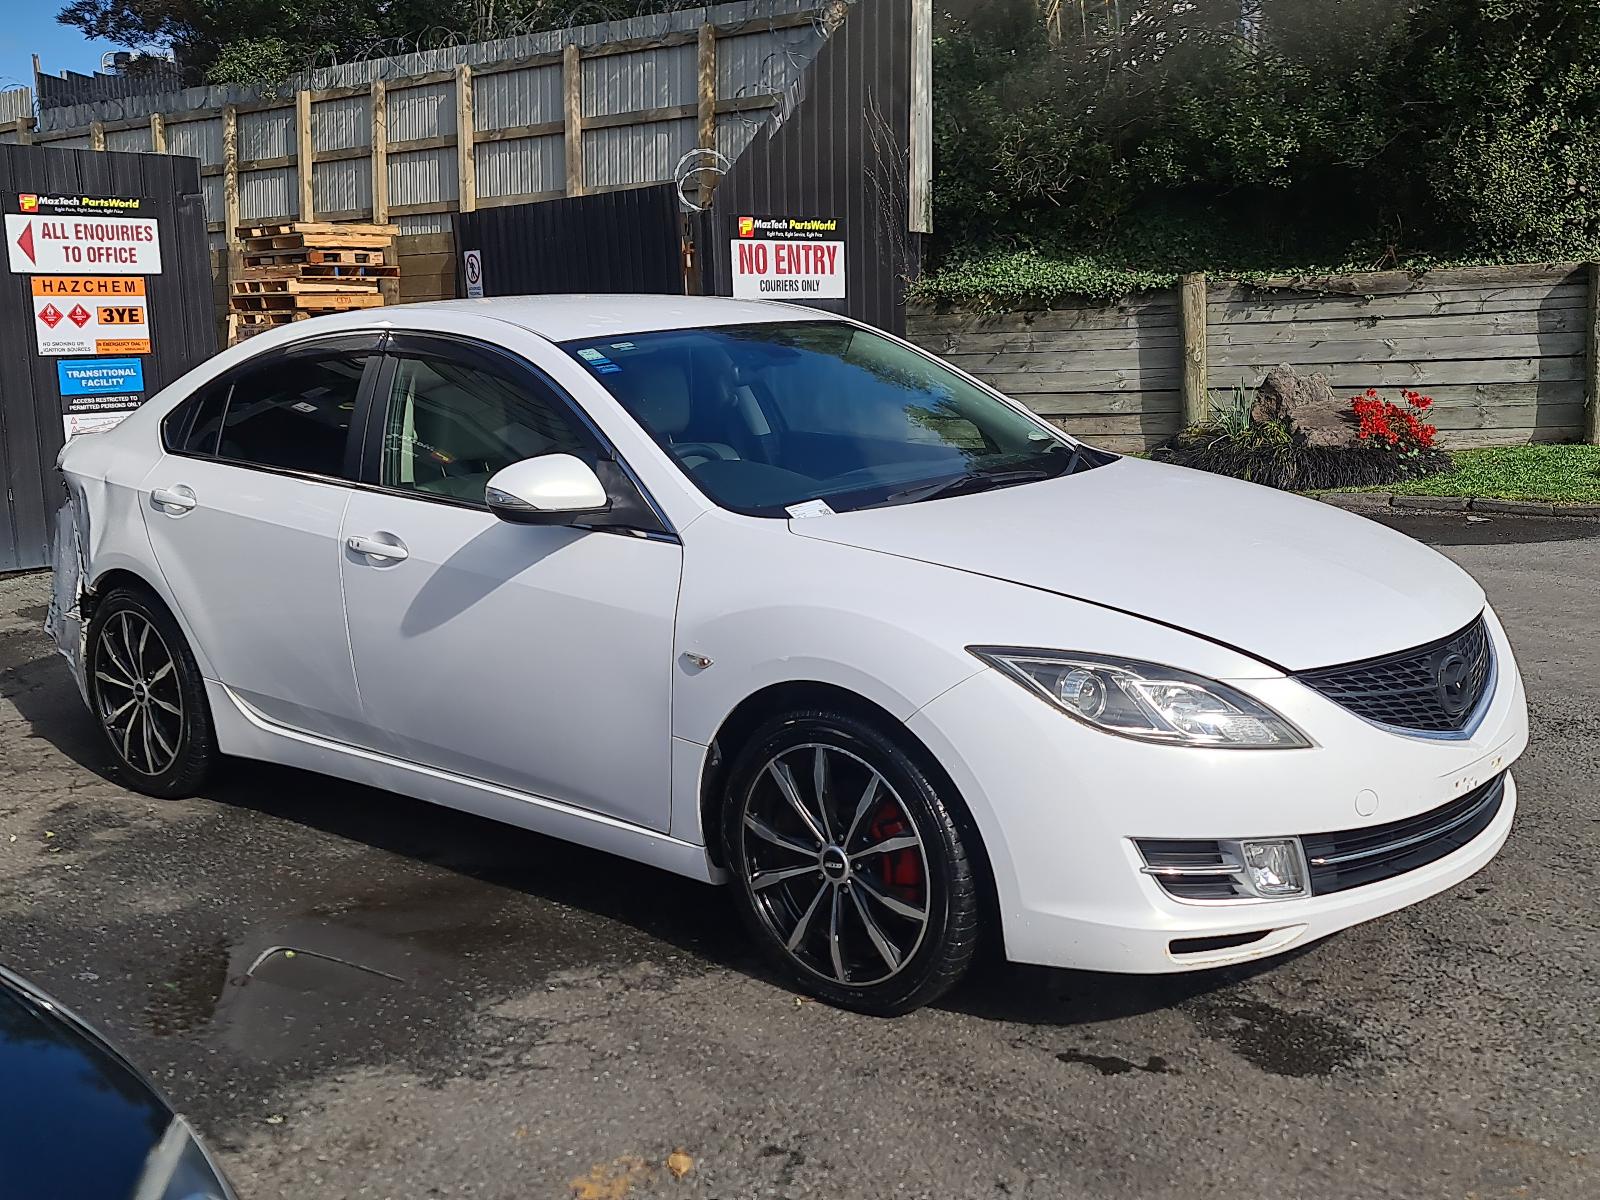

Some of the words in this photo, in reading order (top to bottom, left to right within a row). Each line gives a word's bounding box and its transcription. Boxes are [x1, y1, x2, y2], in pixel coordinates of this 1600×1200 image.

[38, 197, 79, 206] MazTech
[82, 197, 140, 208] PartsWorld
[754, 220, 787, 230] MazTech
[789, 220, 837, 231] PartsWorld
[41, 222, 69, 240] ALL
[74, 223, 153, 242] ENQUIRIES
[62, 246, 82, 262] TO
[86, 246, 138, 264] OFFICE
[738, 243, 768, 275] NO
[775, 244, 838, 275] ENTRY
[42, 280, 136, 293] HAZCHEM
[760, 280, 799, 292] COURIERS
[801, 280, 820, 292] ONLY
[102, 308, 139, 323] 3YE
[66, 368, 136, 379] TRANSITIONAL
[81, 378, 124, 388] FACILITY
[69, 403, 100, 411] PERMITTED
